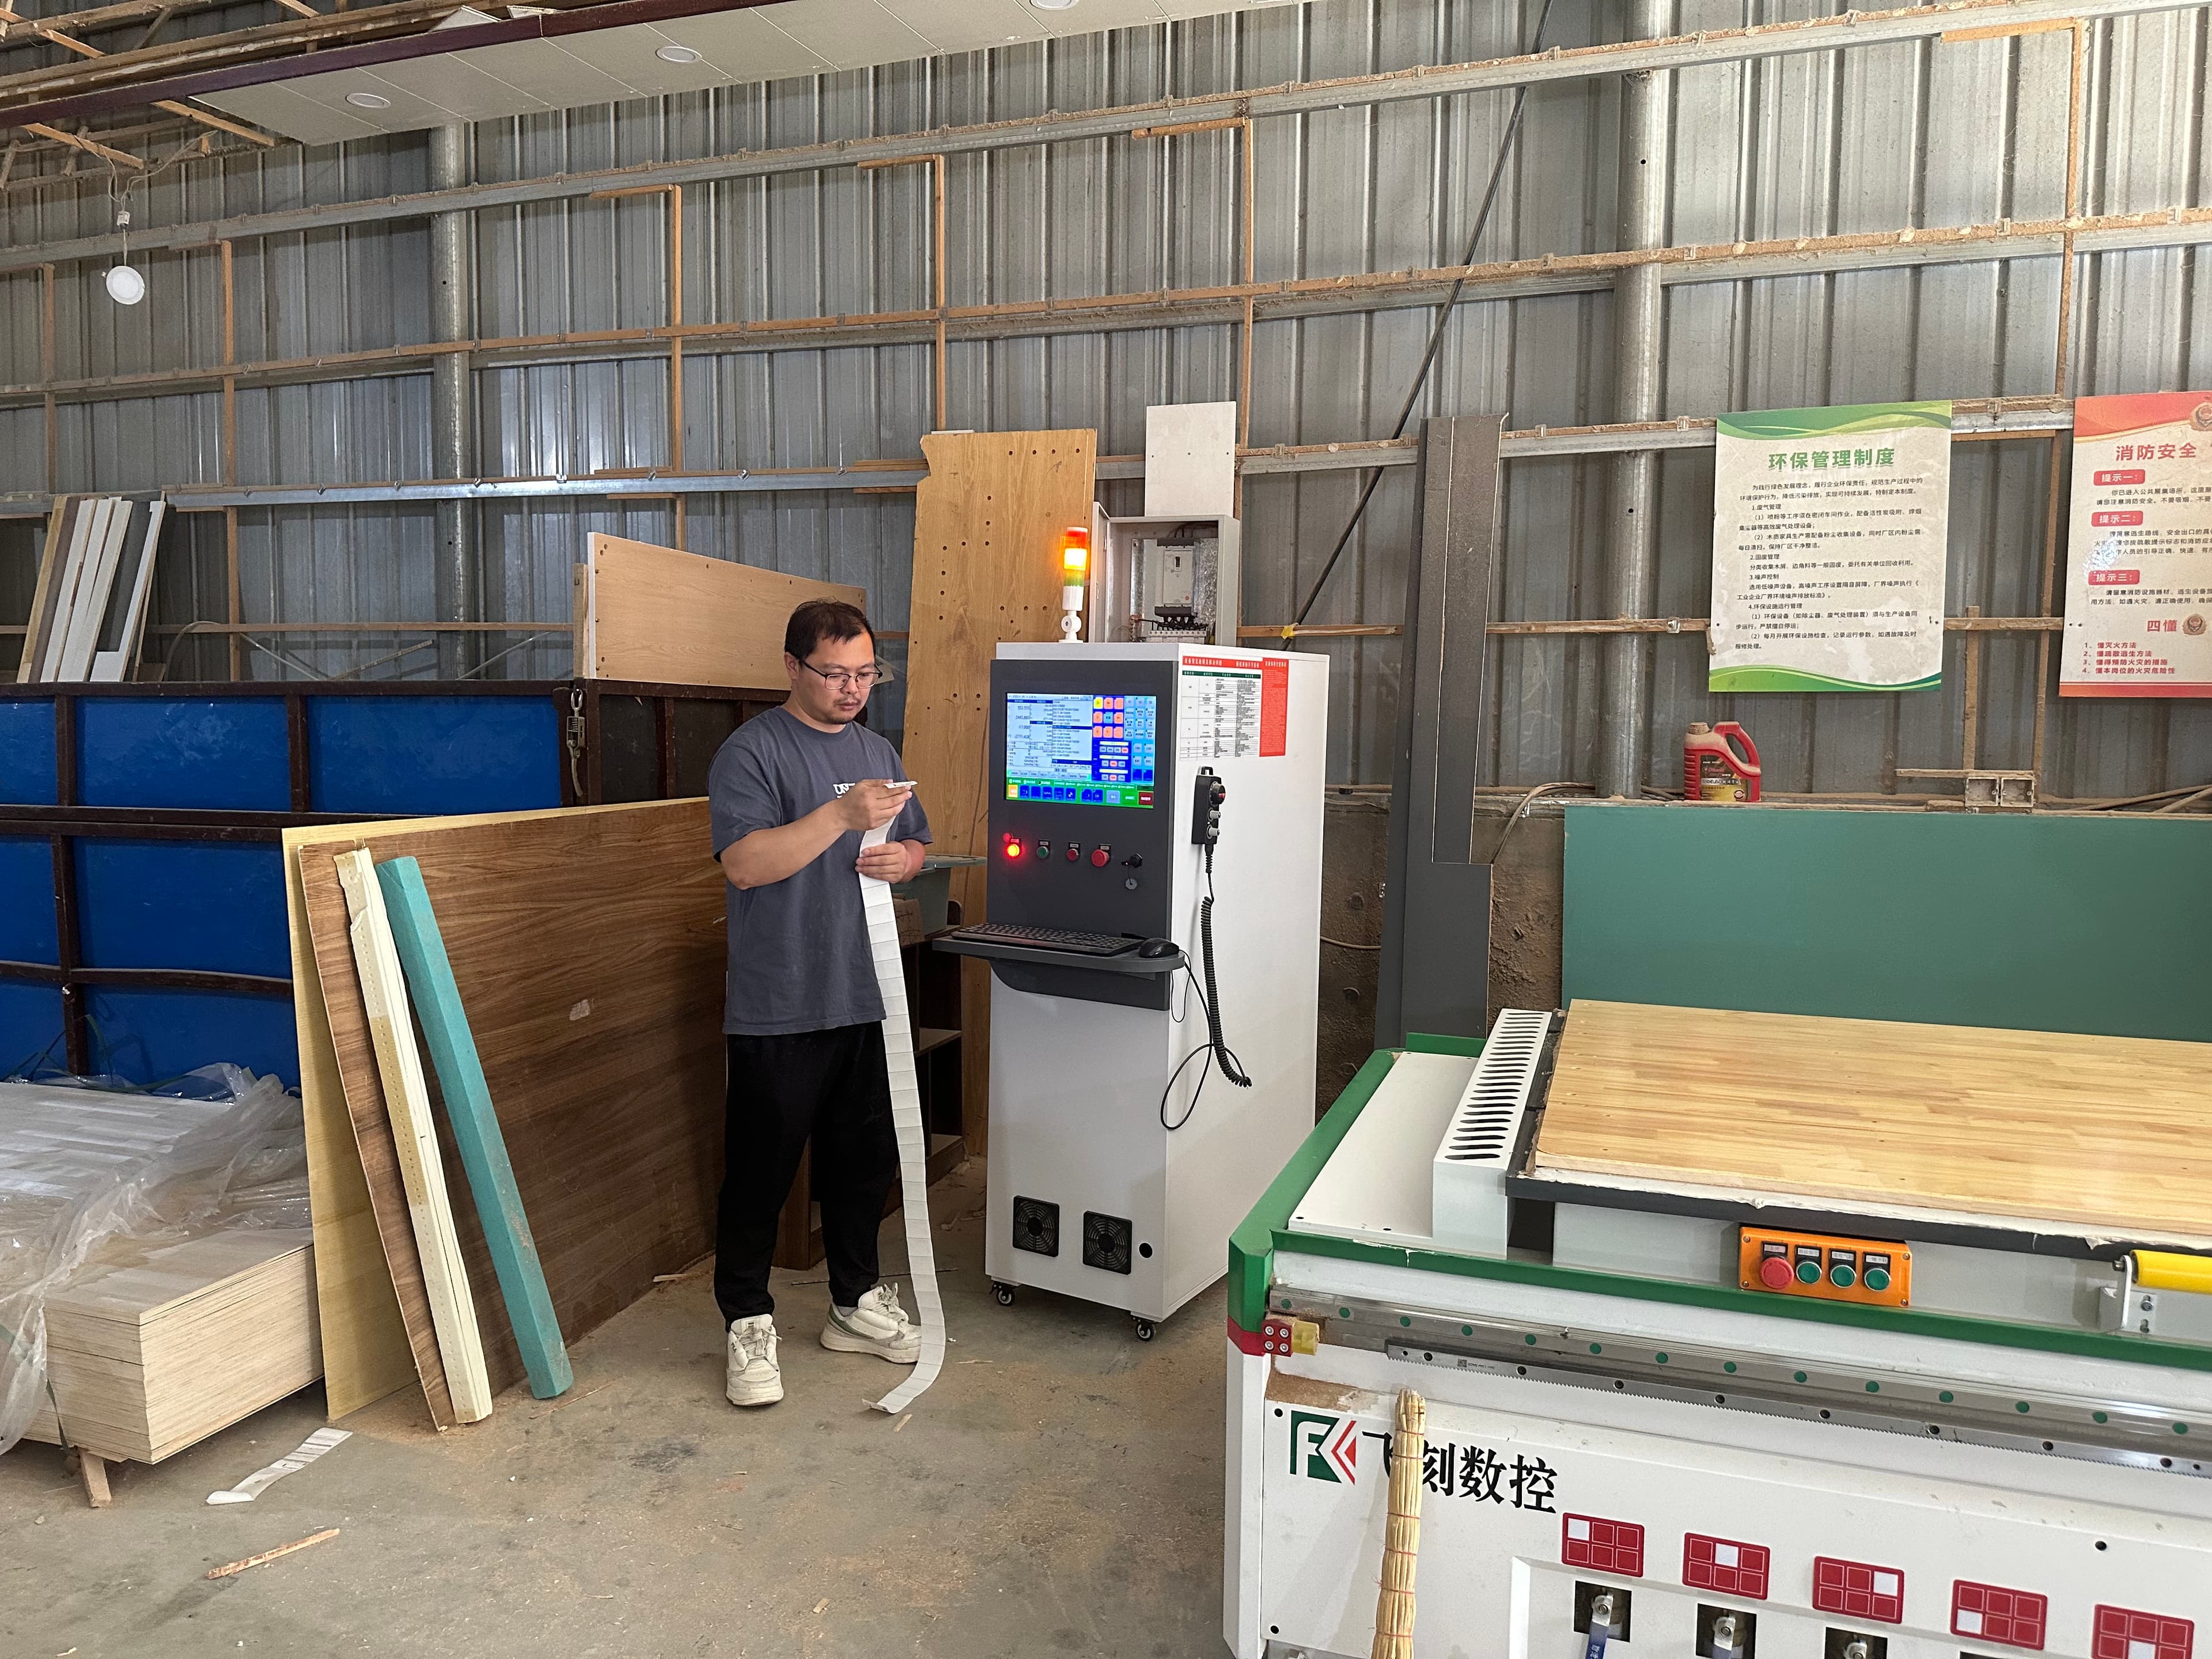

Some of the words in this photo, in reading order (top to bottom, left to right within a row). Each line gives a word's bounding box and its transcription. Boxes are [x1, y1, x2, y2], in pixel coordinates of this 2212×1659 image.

[1768, 448, 1895, 471] 环保管理制度
[2115, 442, 2197, 461] 消防安全
[2147, 619, 2177, 632] 四懂
